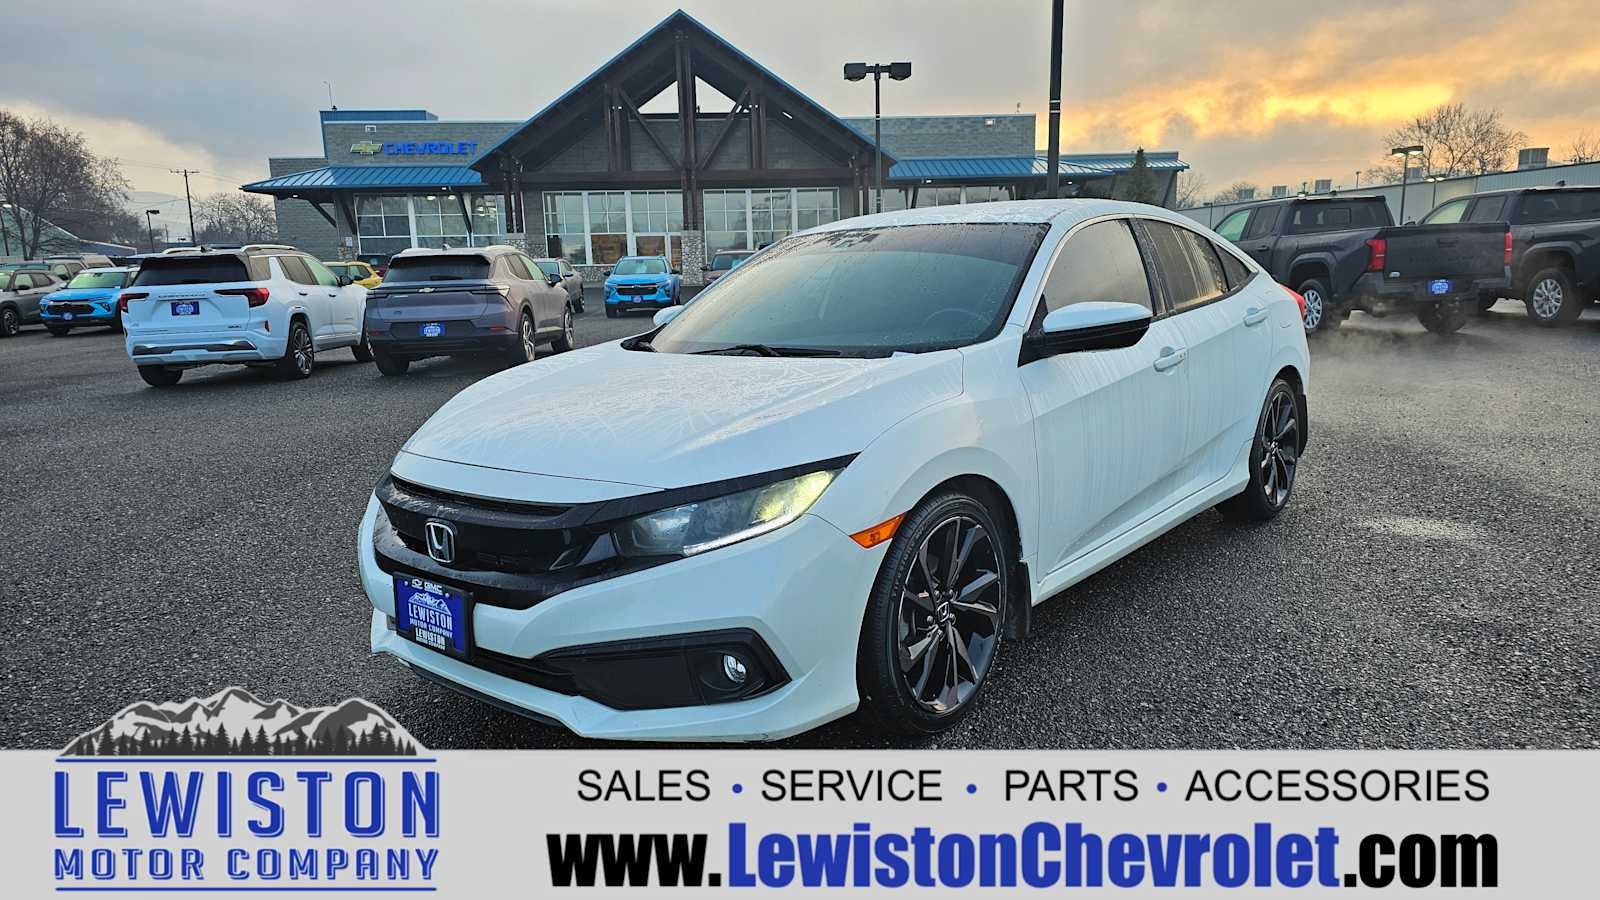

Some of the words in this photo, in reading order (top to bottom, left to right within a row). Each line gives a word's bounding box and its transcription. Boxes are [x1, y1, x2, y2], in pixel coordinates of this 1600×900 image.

[383, 142, 478, 156] CHEVROLET
[424, 582, 443, 594] GMC
[408, 603, 453, 630] LEWISTON
